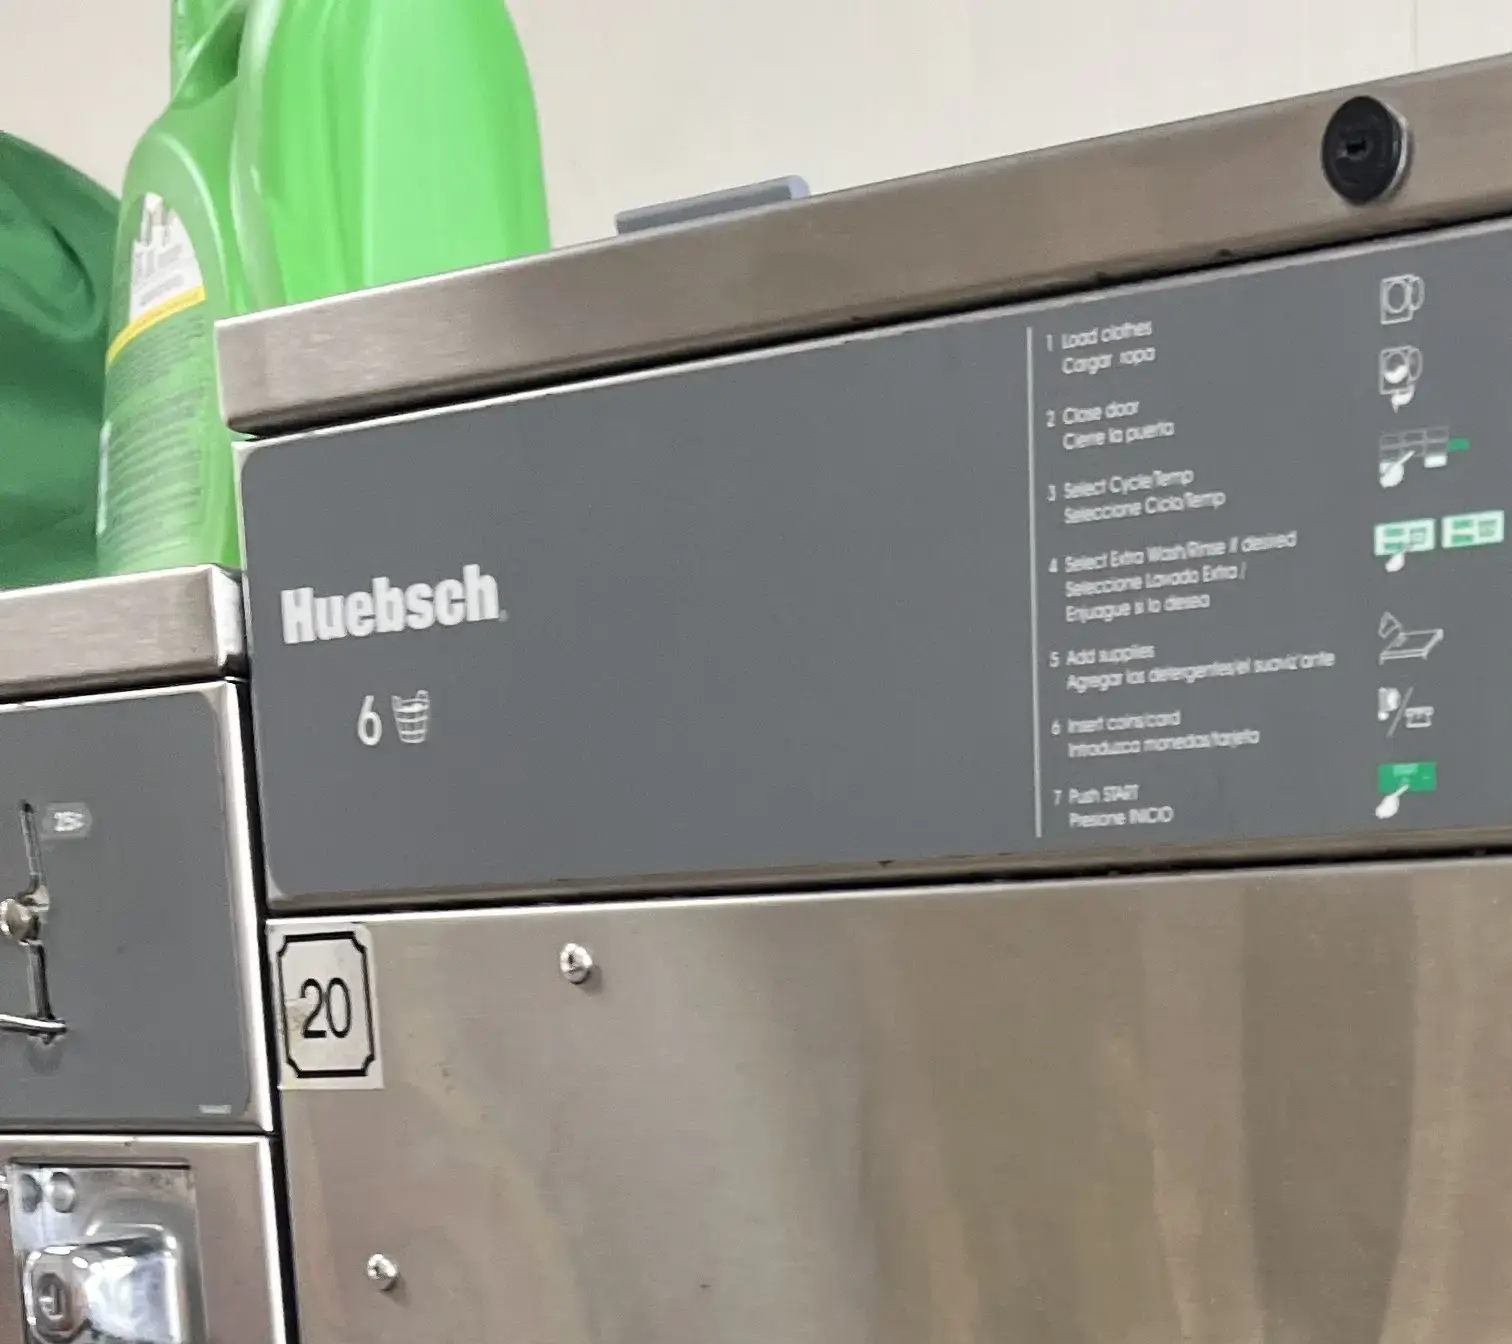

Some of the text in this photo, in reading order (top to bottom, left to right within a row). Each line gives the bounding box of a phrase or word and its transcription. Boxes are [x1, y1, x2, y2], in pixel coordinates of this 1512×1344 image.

[1062, 328, 1099, 349] Load
[1101, 321, 1153, 342] clothes
[1062, 347, 1156, 374] Cargar ropa
[1046, 401, 1140, 427] 2 Close door
[1108, 427, 1124, 443] la
[1125, 421, 1175, 444] puerta
[1048, 484, 1057, 501] 3
[1064, 479, 1106, 499] Select
[1064, 502, 1142, 524] Seleccione
[1048, 556, 1058, 573] 4
[1064, 552, 1108, 573] Select
[1110, 550, 1145, 568] Extra
[1241, 530, 1297, 553] desired
[1065, 576, 1143, 597] Seleccione
[1145, 570, 1200, 589] Lavado
[1202, 564, 1238, 583] Extra
[280, 563, 500, 645] Huebsch
[1065, 602, 1131, 623] Enjuague
[1147, 598, 1162, 613] lo
[1163, 594, 1210, 611] desea
[1049, 644, 1155, 668] 5 Add supplies
[1066, 672, 1123, 693] Agregar
[1126, 669, 1145, 684] los
[357, 695, 382, 746] 6
[1051, 720, 1061, 736] 6
[1067, 717, 1104, 734] Insert
[1068, 740, 1141, 758] Introduzca
[1053, 784, 1139, 806] 7 Push START
[1069, 805, 1174, 828] Presione INICIO
[300, 977, 352, 1039] 20
